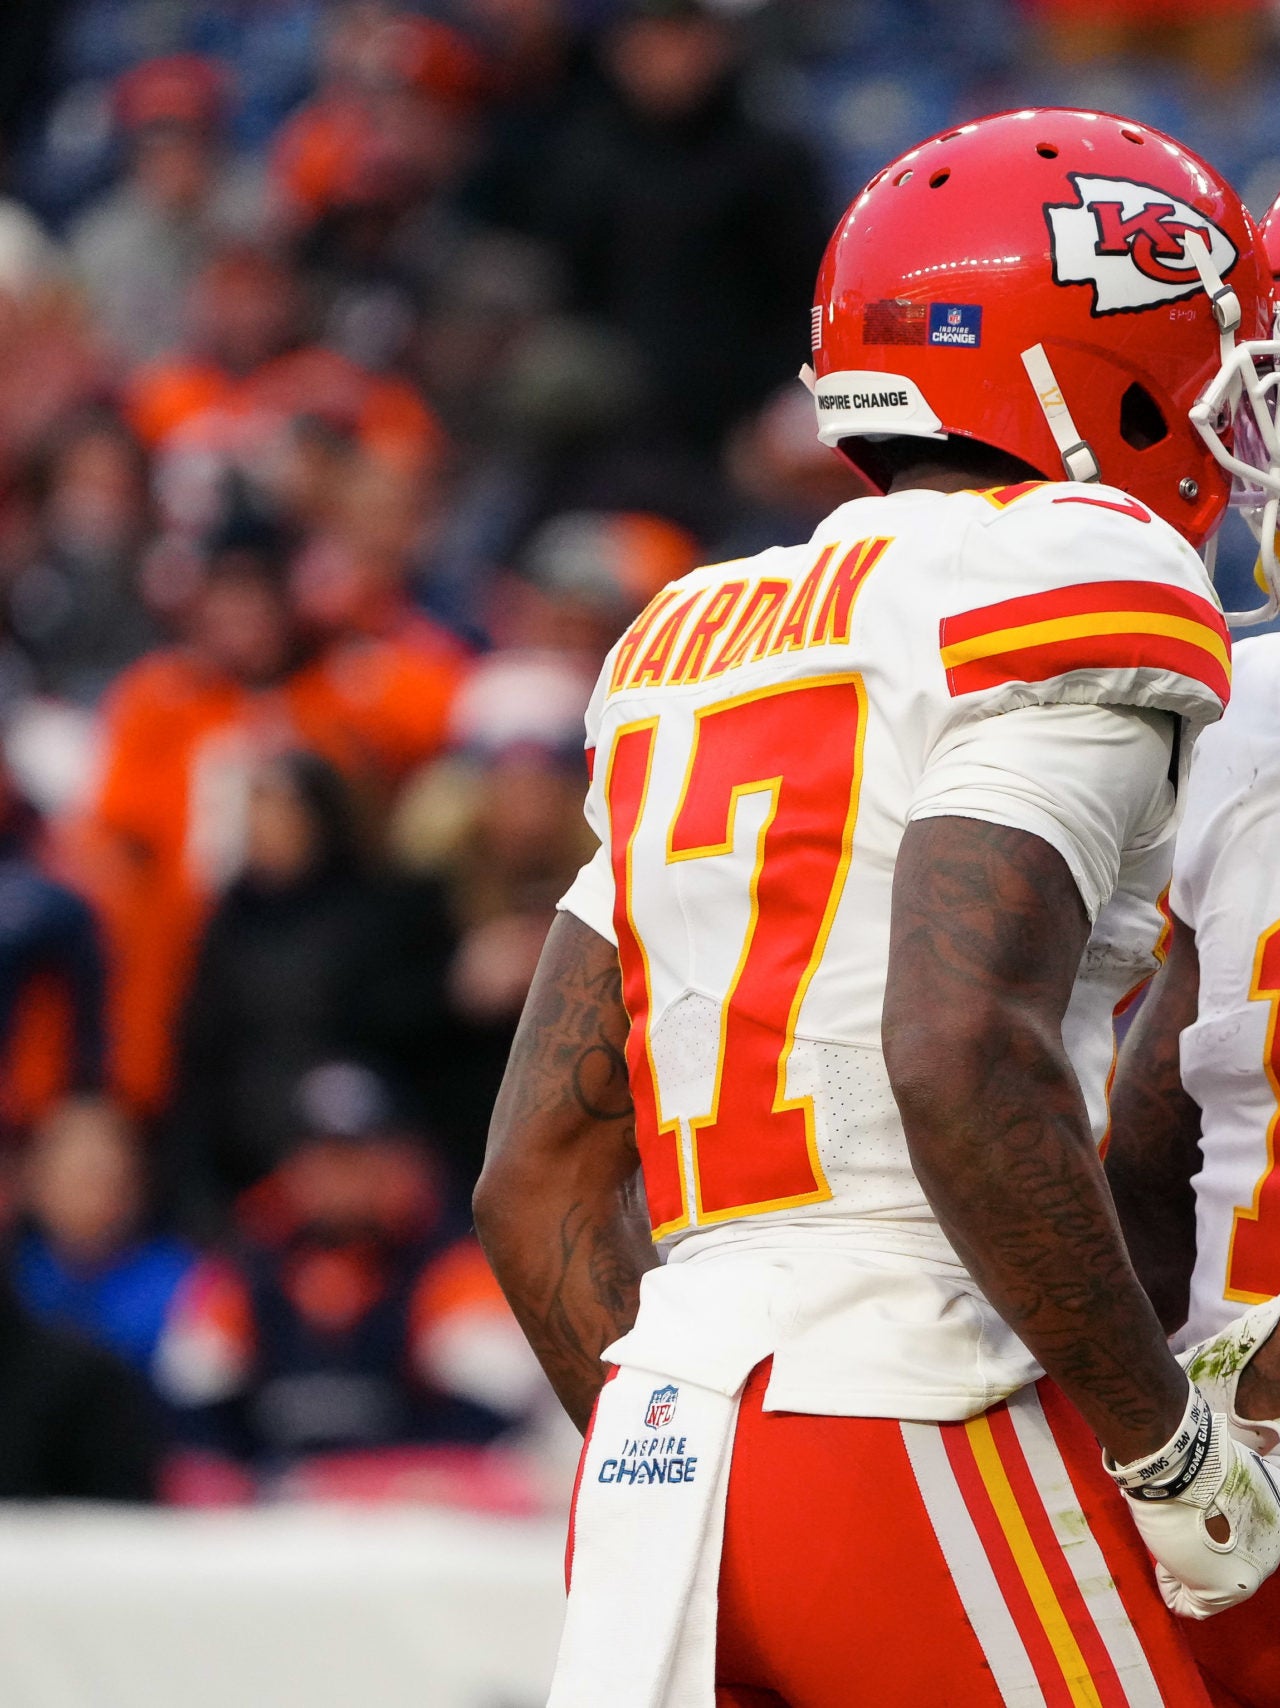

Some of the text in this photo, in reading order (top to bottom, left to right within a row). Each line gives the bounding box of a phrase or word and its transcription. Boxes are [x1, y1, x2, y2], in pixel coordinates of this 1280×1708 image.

[1087, 201, 1213, 284] KC
[932, 332, 976, 344] CHANGE
[817, 391, 909, 410] INSPIRE CHANGE
[604, 672, 868, 1243] 17
[647, 1403, 672, 1428] NFL
[622, 1437, 687, 1457] INSPIRE
[598, 1457, 698, 1485] CHANGE
[1136, 1456, 1170, 1481] SAVAGE
[1182, 1442, 1205, 1484] SOME
